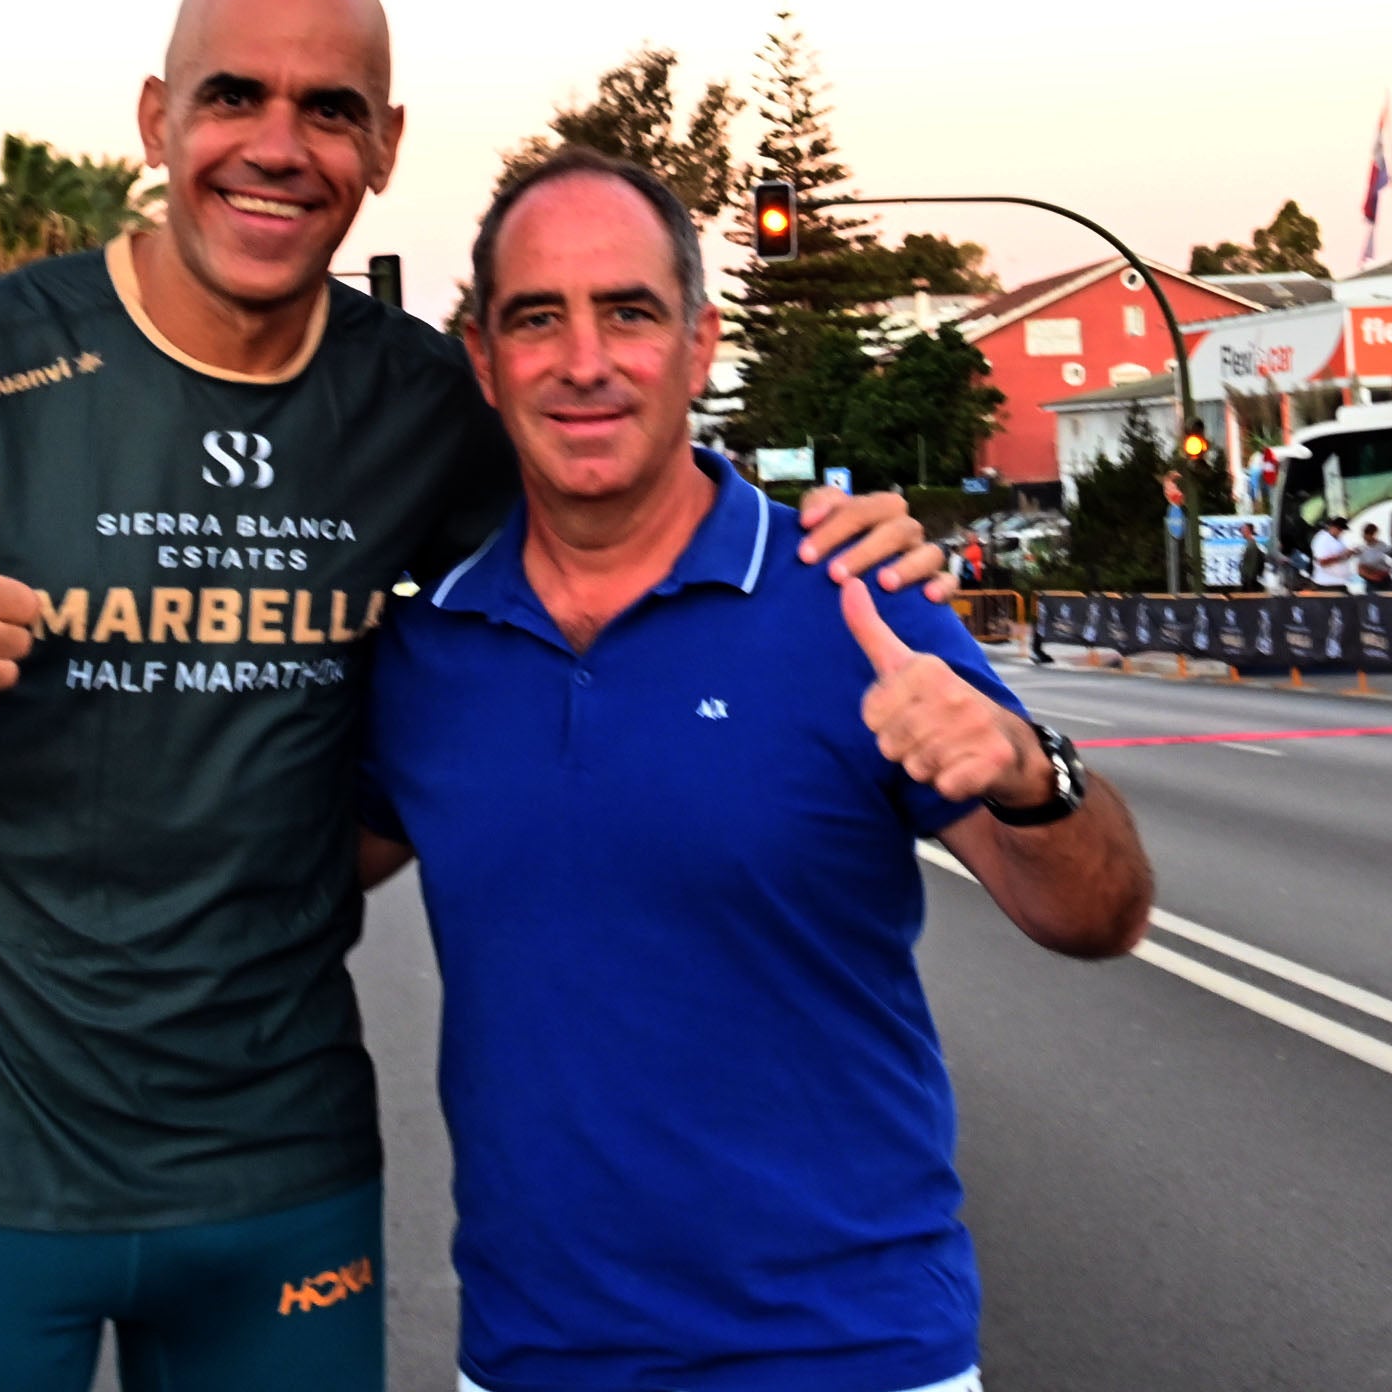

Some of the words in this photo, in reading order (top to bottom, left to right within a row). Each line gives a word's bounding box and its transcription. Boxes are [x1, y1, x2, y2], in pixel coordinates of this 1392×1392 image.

[201, 430, 275, 489] SB
[95, 512, 223, 537] SIERRA
[235, 514, 357, 542] BLANCA
[157, 545, 308, 571] ESTATES
[65, 658, 168, 693] HALF
